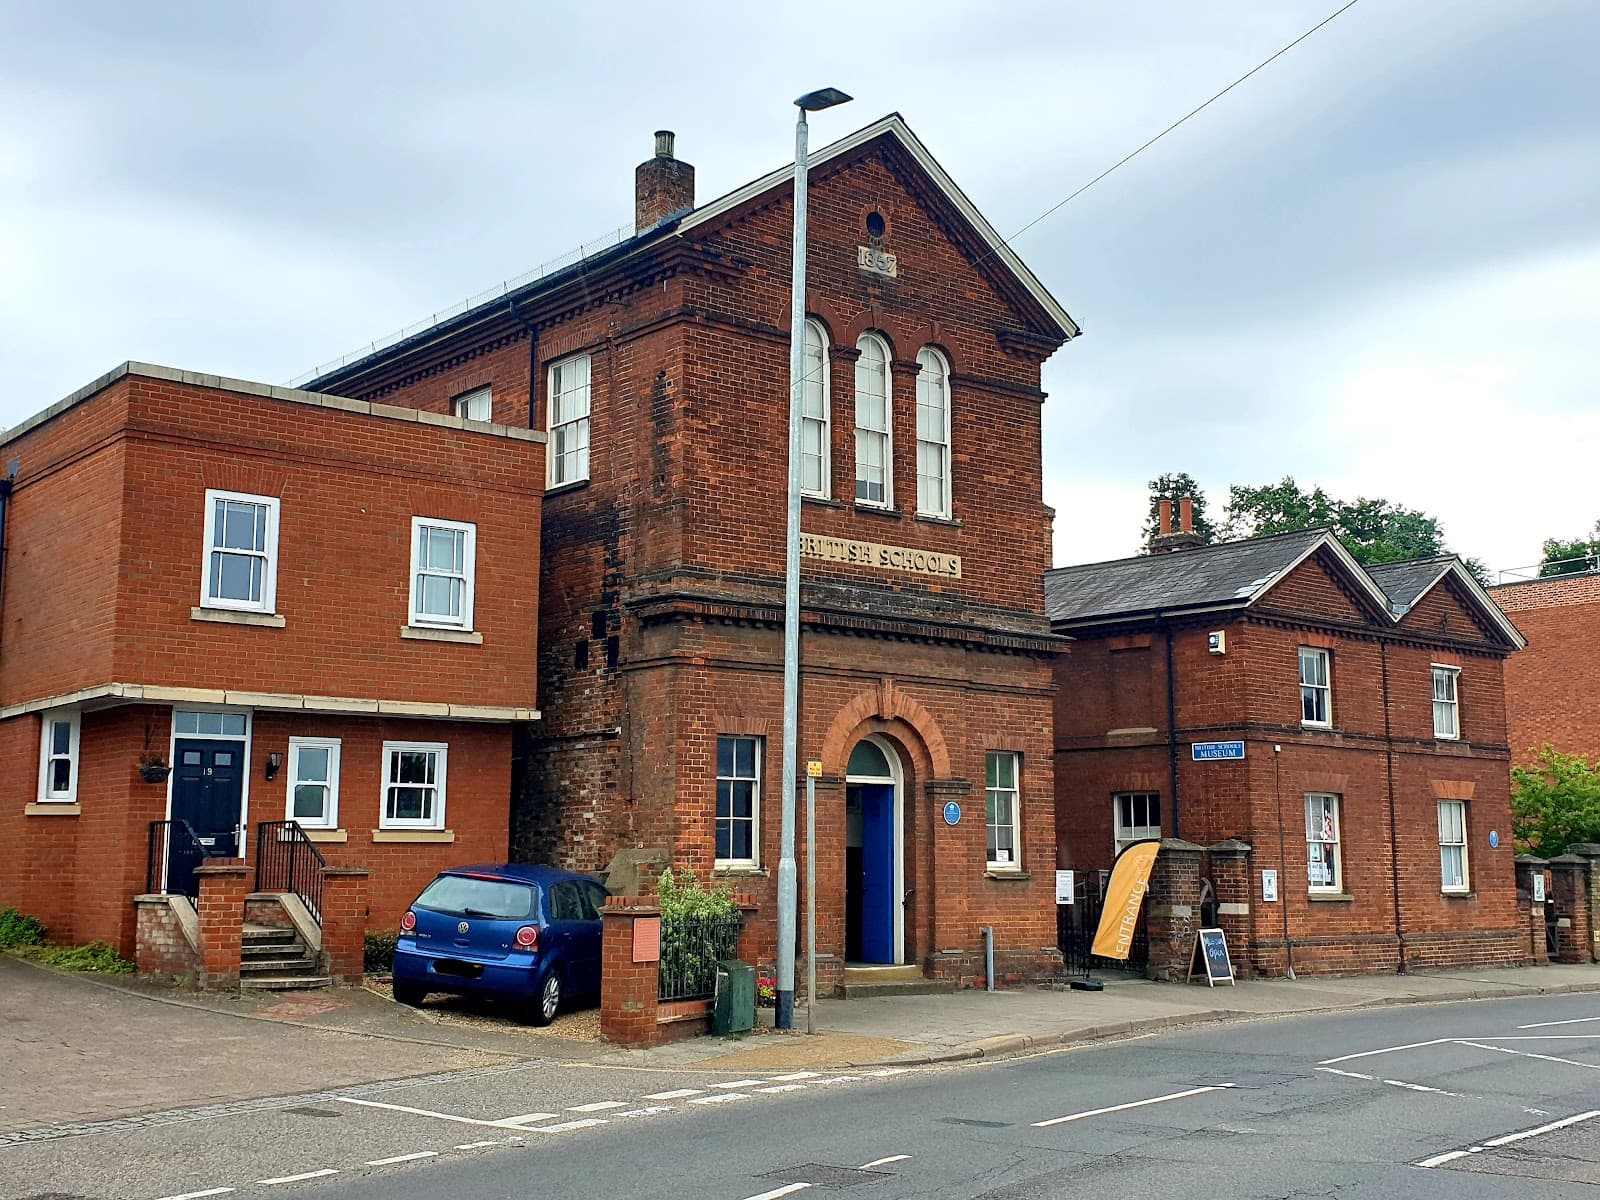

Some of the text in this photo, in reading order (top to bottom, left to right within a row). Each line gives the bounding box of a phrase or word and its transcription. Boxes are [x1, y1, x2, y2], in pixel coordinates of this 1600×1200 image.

[859, 248, 897, 273] 1857
[879, 549, 958, 576] SCHOOLS
[1200, 749, 1236, 758] MUSEUM
[203, 767, 213, 776] 19
[1116, 879, 1148, 955] ENTRANCE
